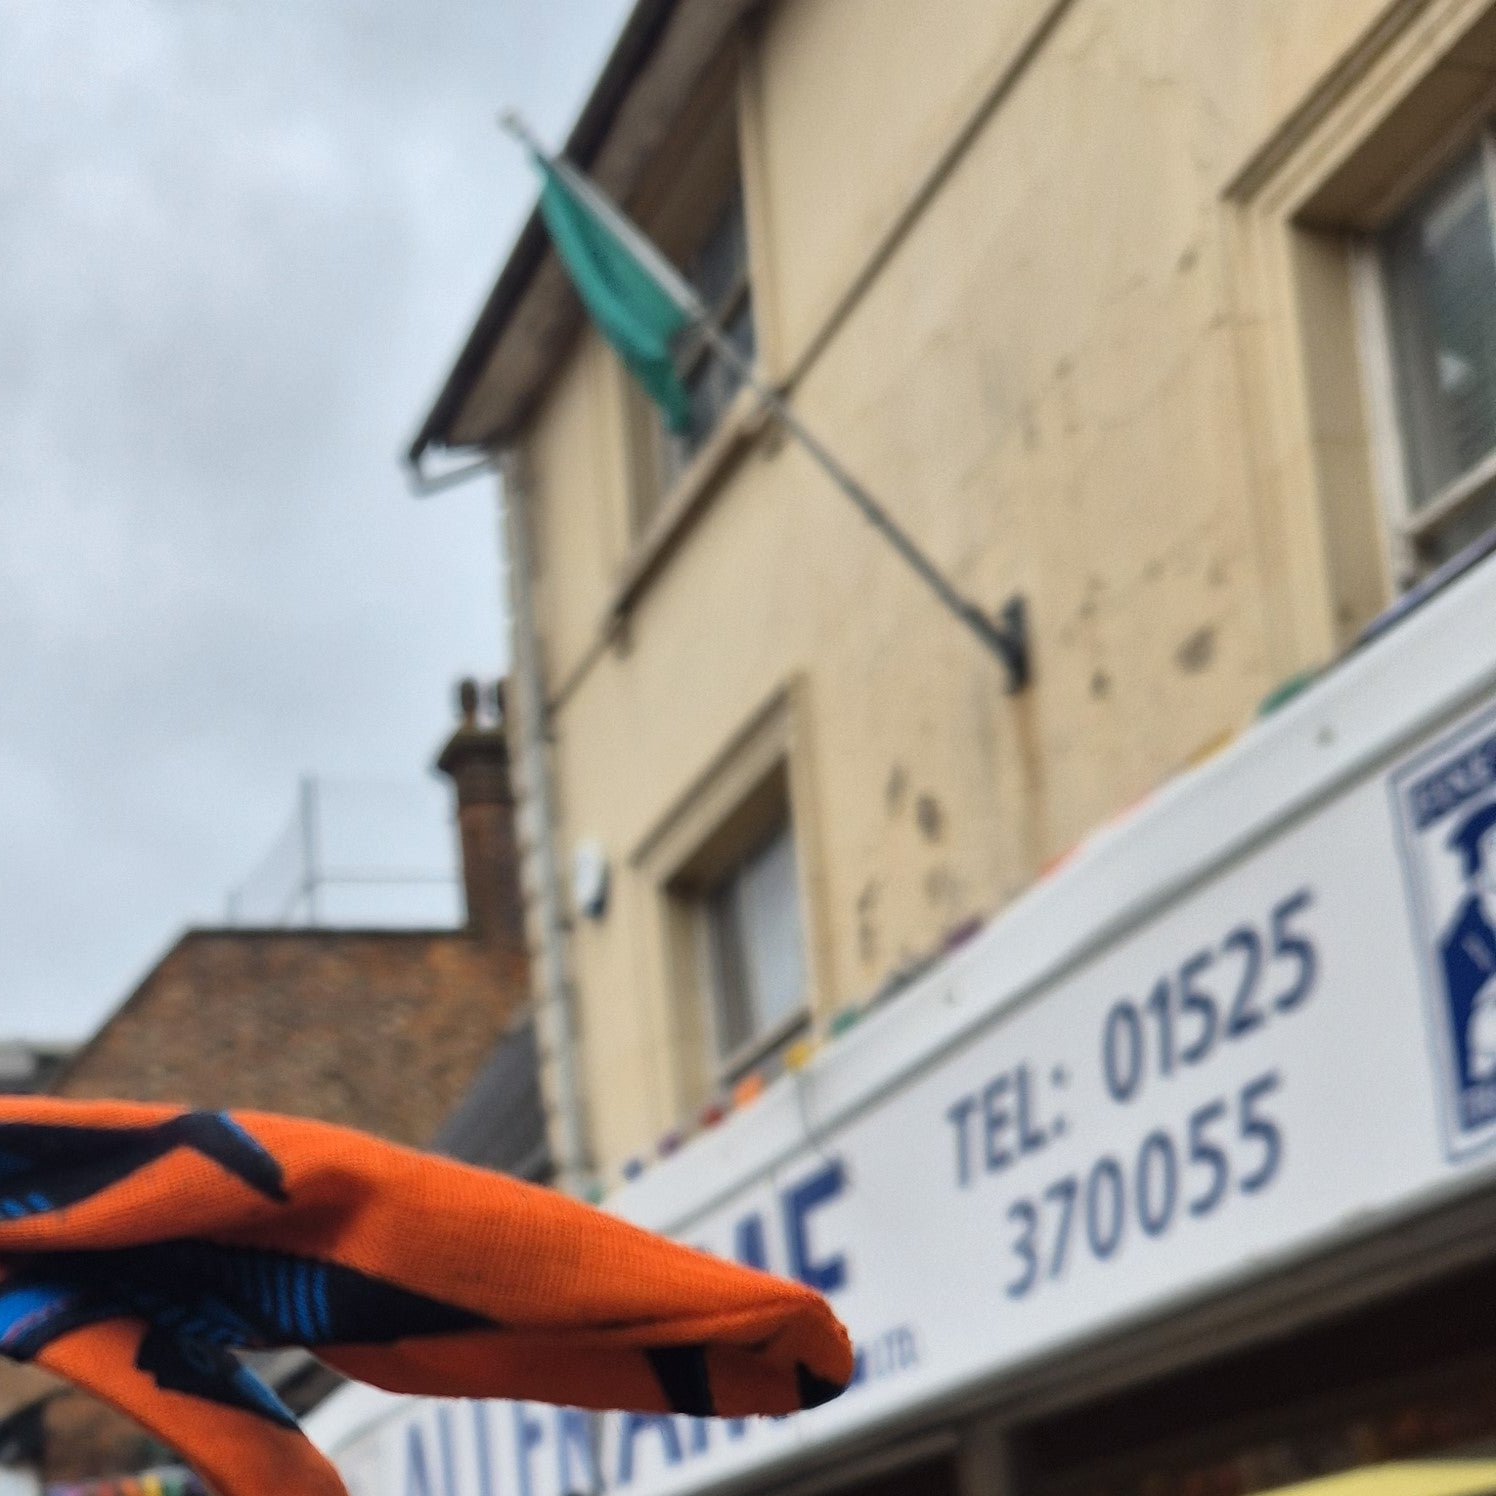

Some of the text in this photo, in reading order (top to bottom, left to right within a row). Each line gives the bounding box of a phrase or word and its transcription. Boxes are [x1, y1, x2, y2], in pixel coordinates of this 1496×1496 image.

[947, 888, 1319, 1189] TEL: 01525
[1006, 1069, 1283, 1301] 370055
